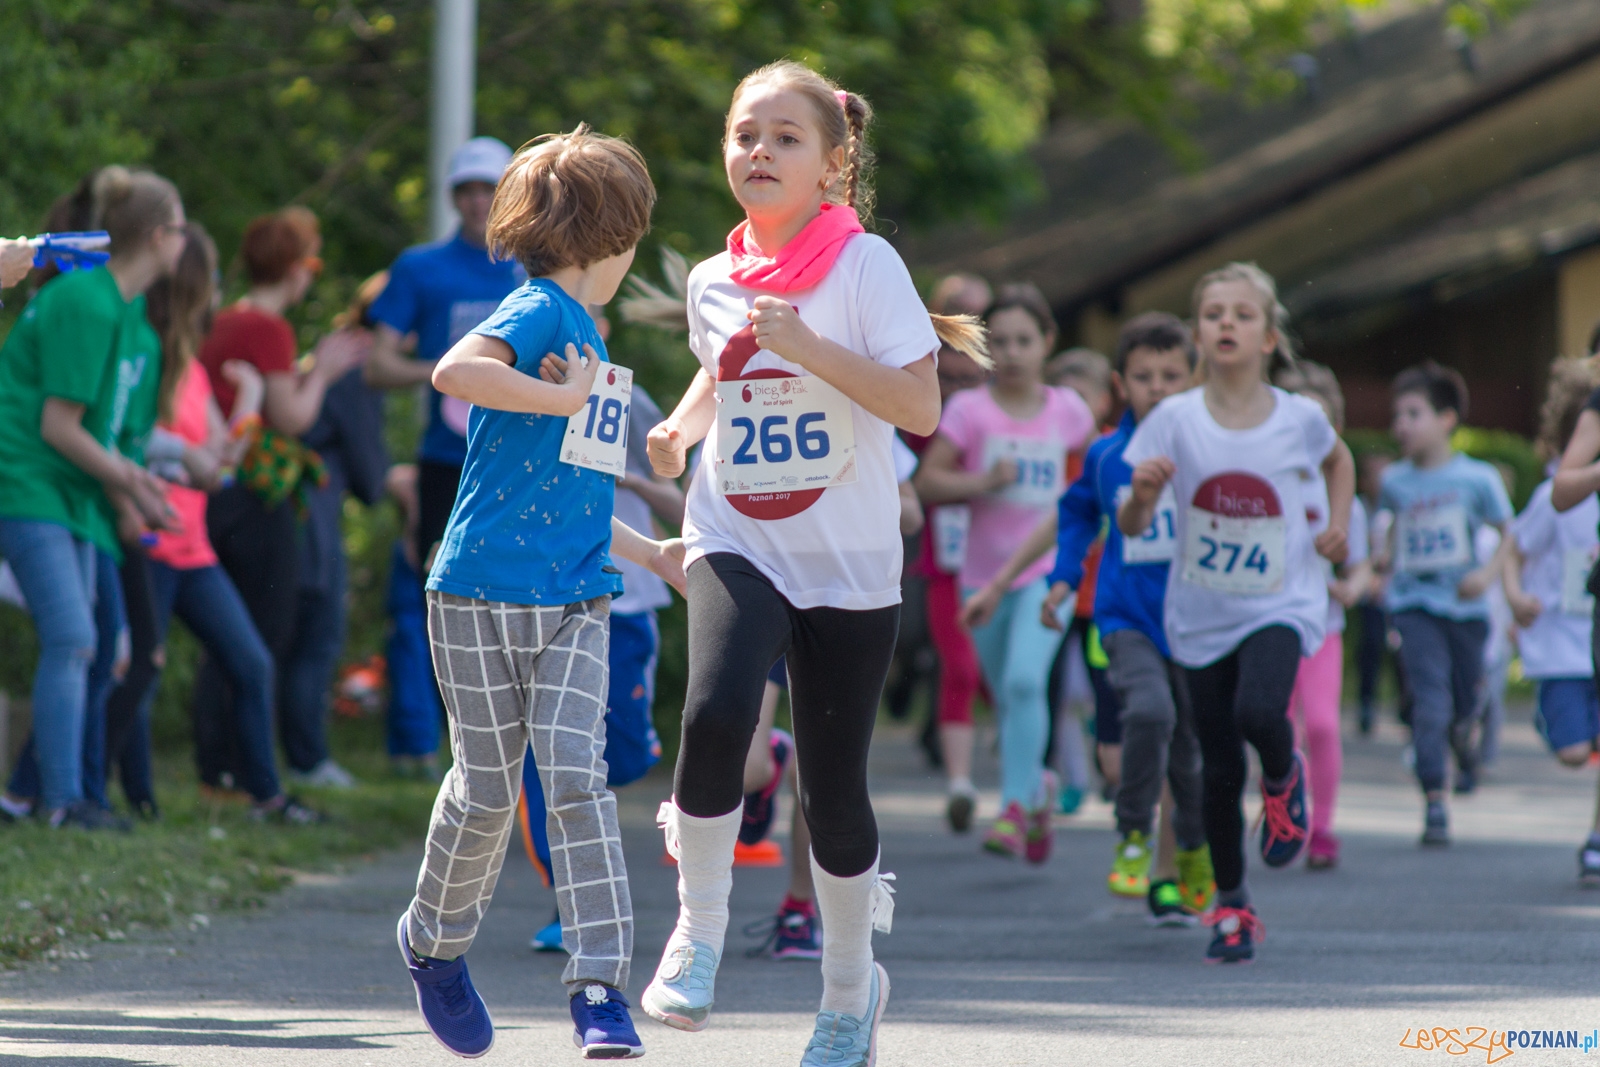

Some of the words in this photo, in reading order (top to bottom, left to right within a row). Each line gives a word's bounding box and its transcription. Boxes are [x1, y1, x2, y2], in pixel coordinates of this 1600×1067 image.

[754, 382, 780, 399] bieg
[792, 386, 808, 394] tak
[584, 393, 630, 449] 181
[731, 412, 830, 465] 266
[748, 491, 774, 502] Poznań
[775, 492, 791, 501] 2017
[1198, 534, 1269, 575] 274
